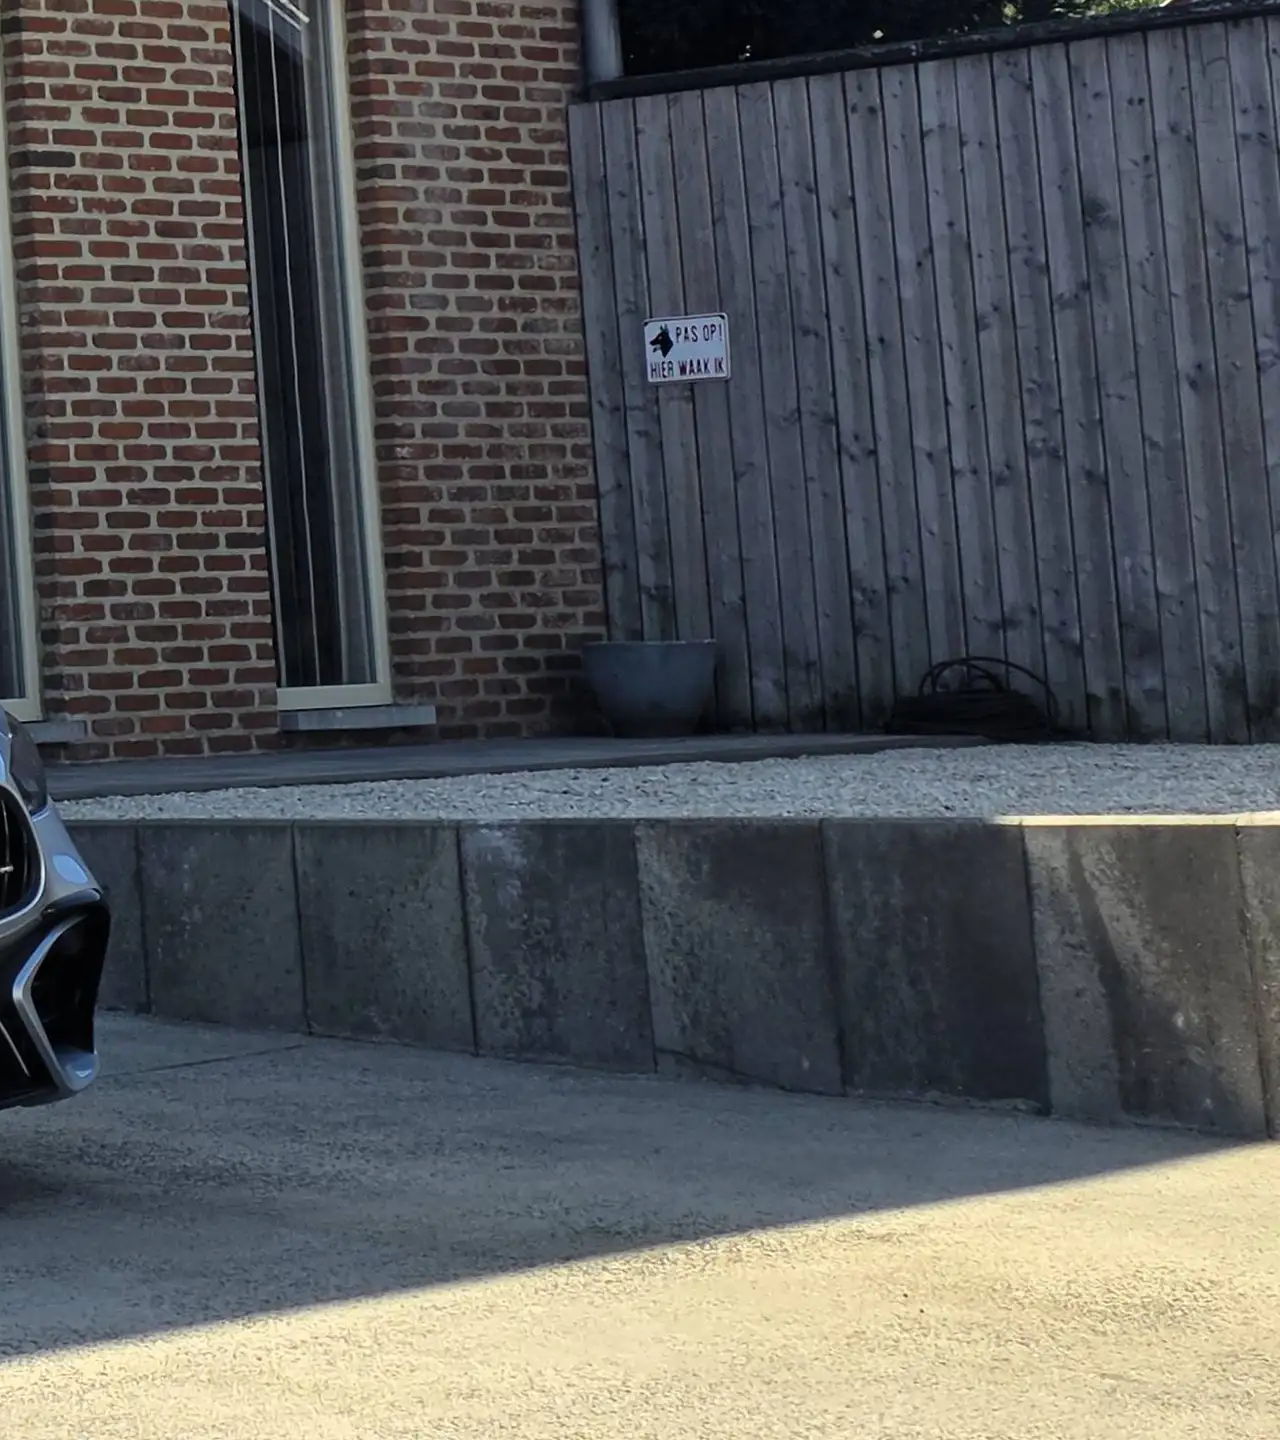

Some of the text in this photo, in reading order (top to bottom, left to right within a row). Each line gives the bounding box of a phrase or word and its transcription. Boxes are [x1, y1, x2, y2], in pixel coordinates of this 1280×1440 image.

[676, 326, 699, 343] PAS
[650, 357, 725, 378] HIER WAAK IK
